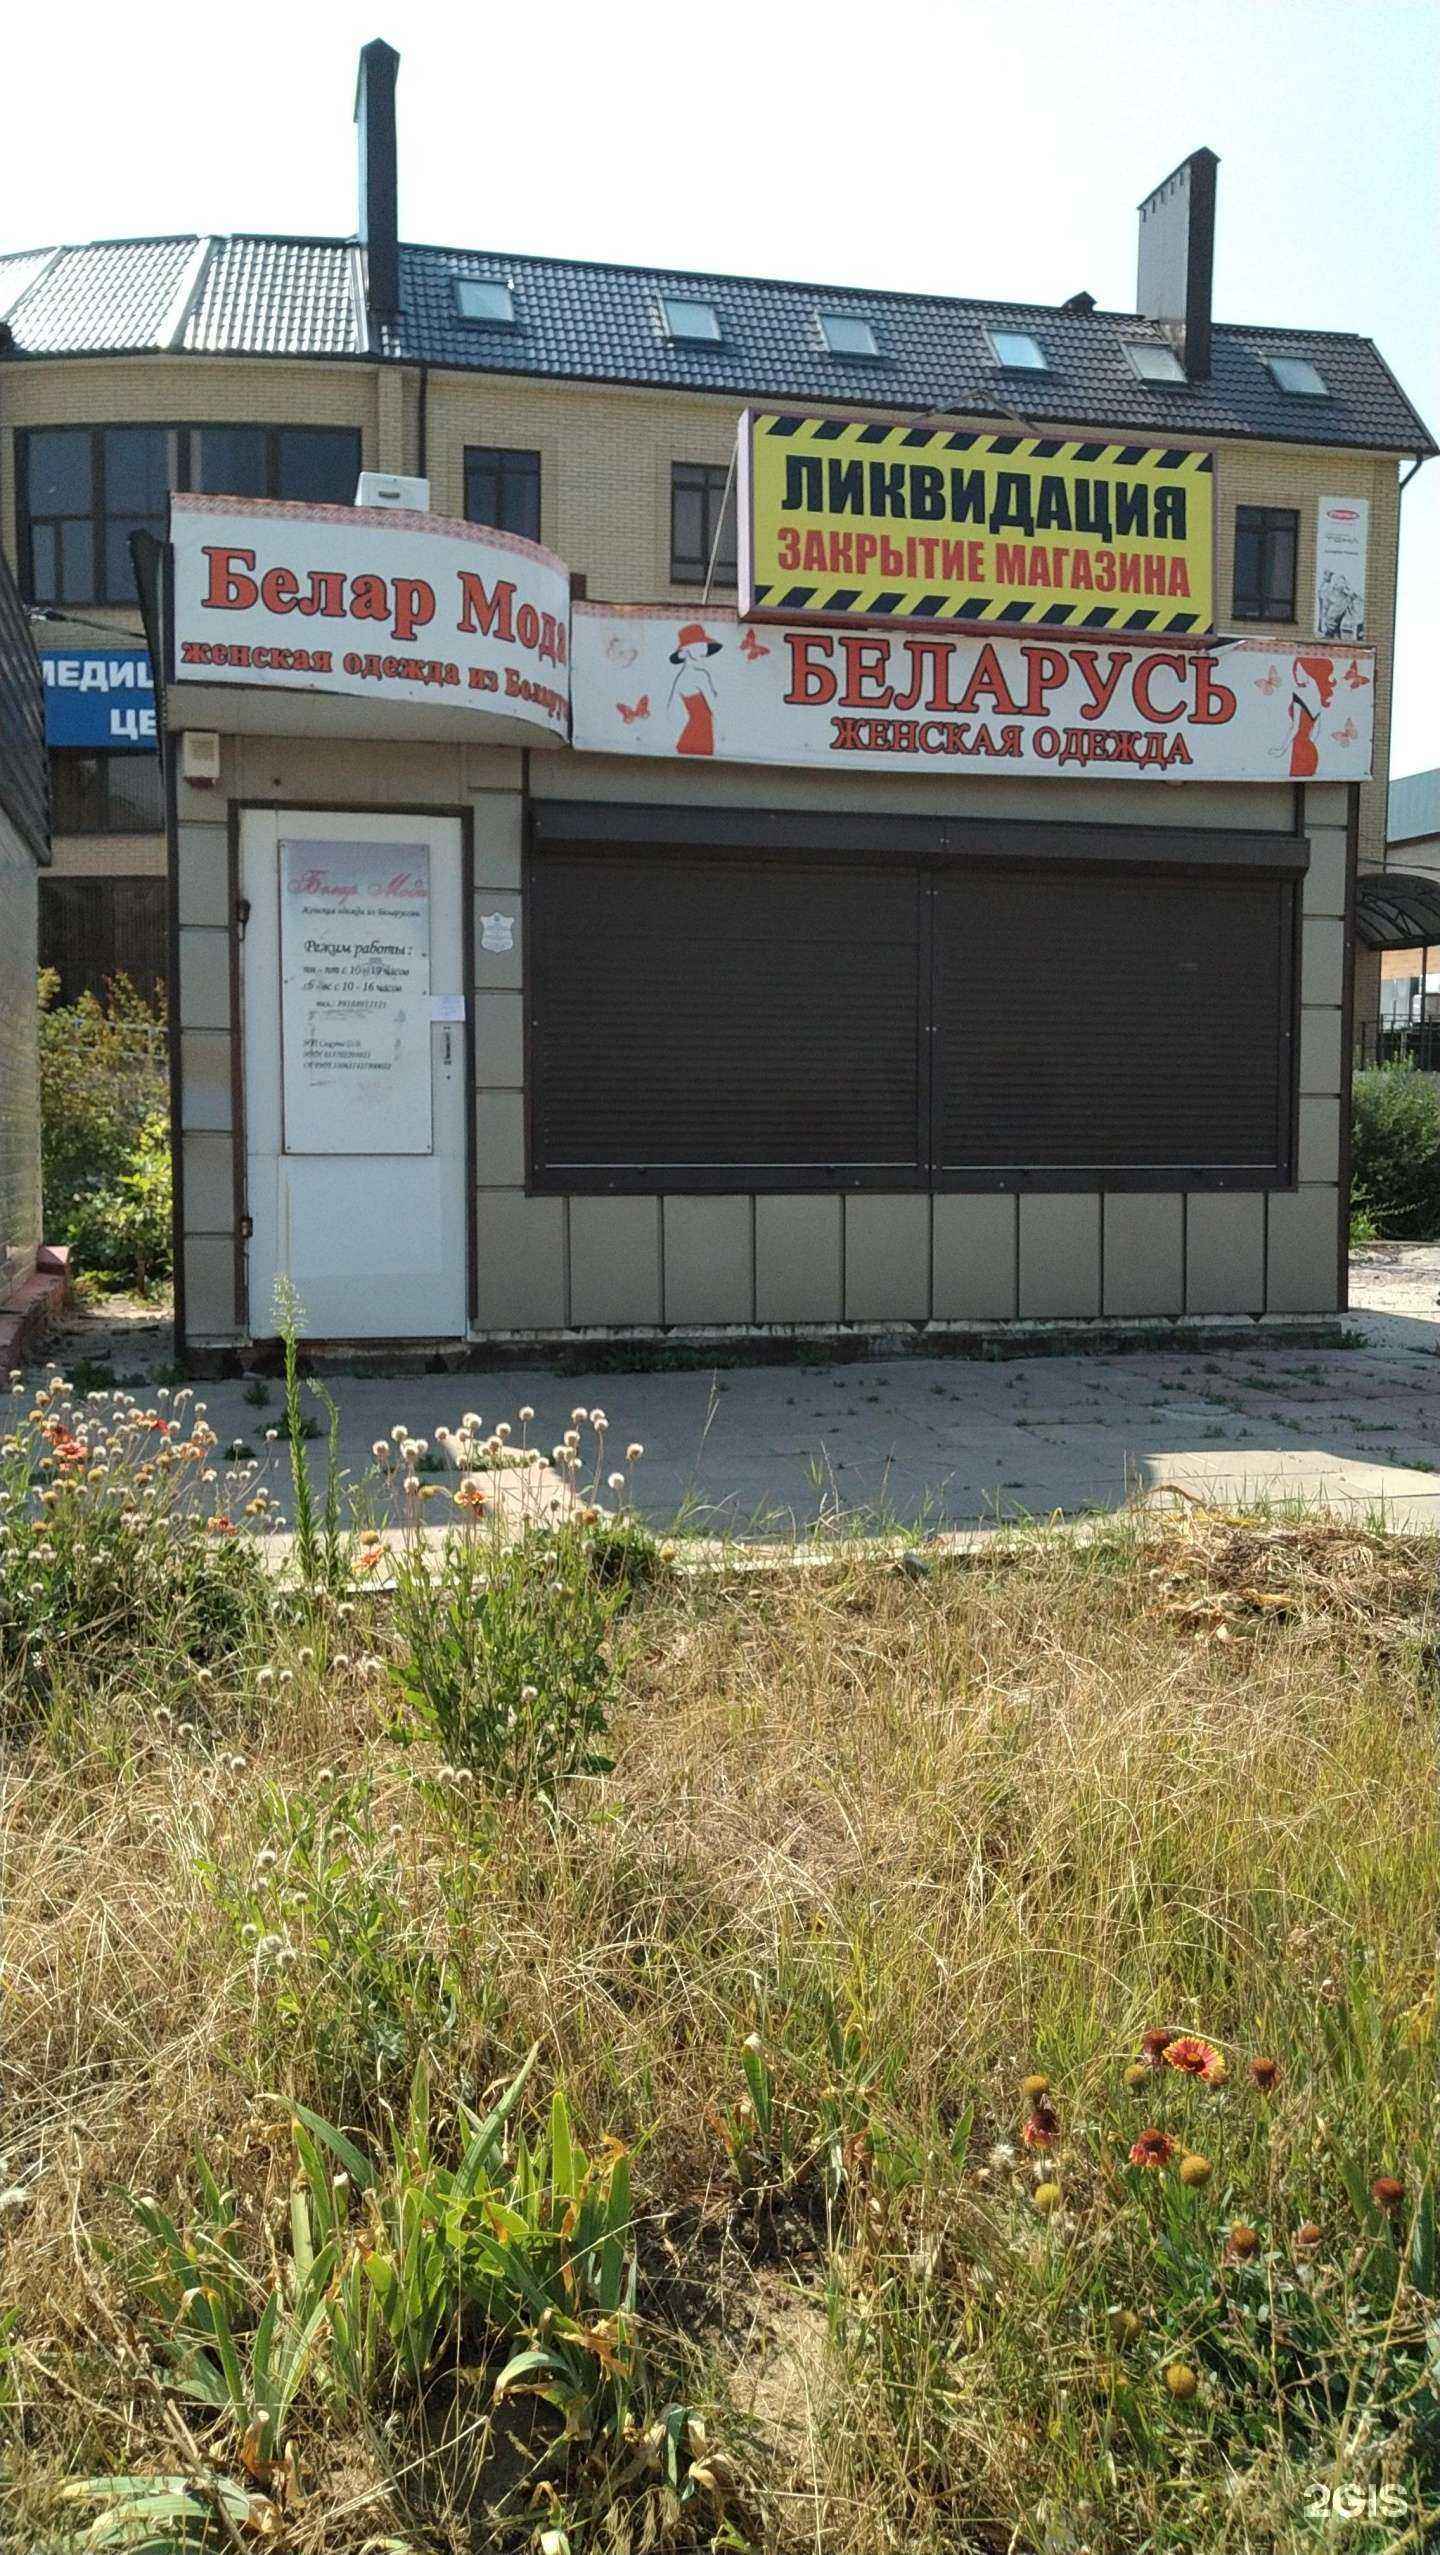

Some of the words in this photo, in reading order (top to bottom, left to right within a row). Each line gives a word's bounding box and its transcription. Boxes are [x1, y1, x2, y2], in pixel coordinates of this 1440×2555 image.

[781, 454, 1187, 544] ЛИКВИДАЦИЯ
[777, 526, 986, 582] ЗАКРЫТИЕ
[995, 542, 1191, 598] МАГАЗИНА
[201, 545, 436, 641] Белар
[457, 570, 567, 668] Мода
[181, 641, 333, 673] женская
[343, 651, 461, 688] одежда
[468, 667, 499, 692] из
[784, 633, 1238, 725] БЕЛАРУСЬ
[829, 716, 1024, 758] ЖЕНСКАЯ
[1032, 725, 1194, 771] ОДЕЖДА
[304, 940, 352, 957] Режим
